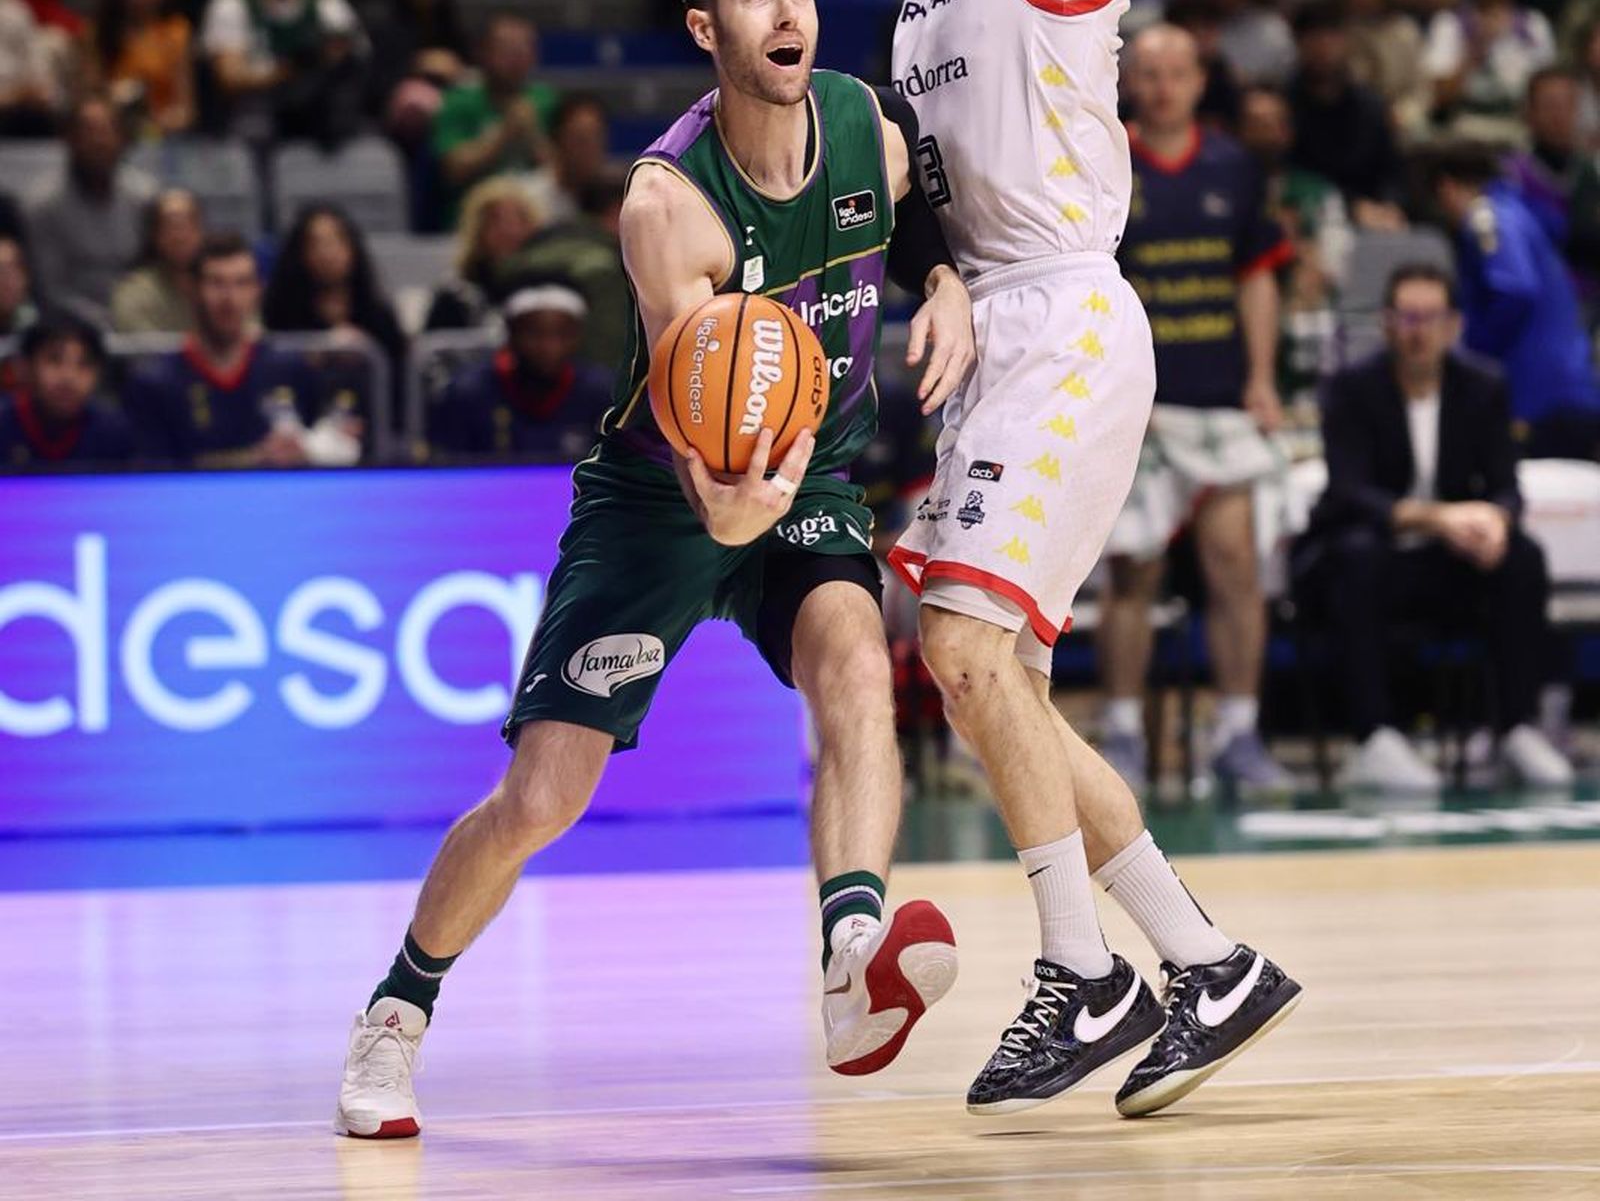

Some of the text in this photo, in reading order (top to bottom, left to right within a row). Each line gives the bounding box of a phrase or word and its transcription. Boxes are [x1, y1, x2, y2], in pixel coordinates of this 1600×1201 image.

[739, 319, 784, 435] Wilson
[811, 355, 823, 405] acb
[970, 468, 994, 479] acb
